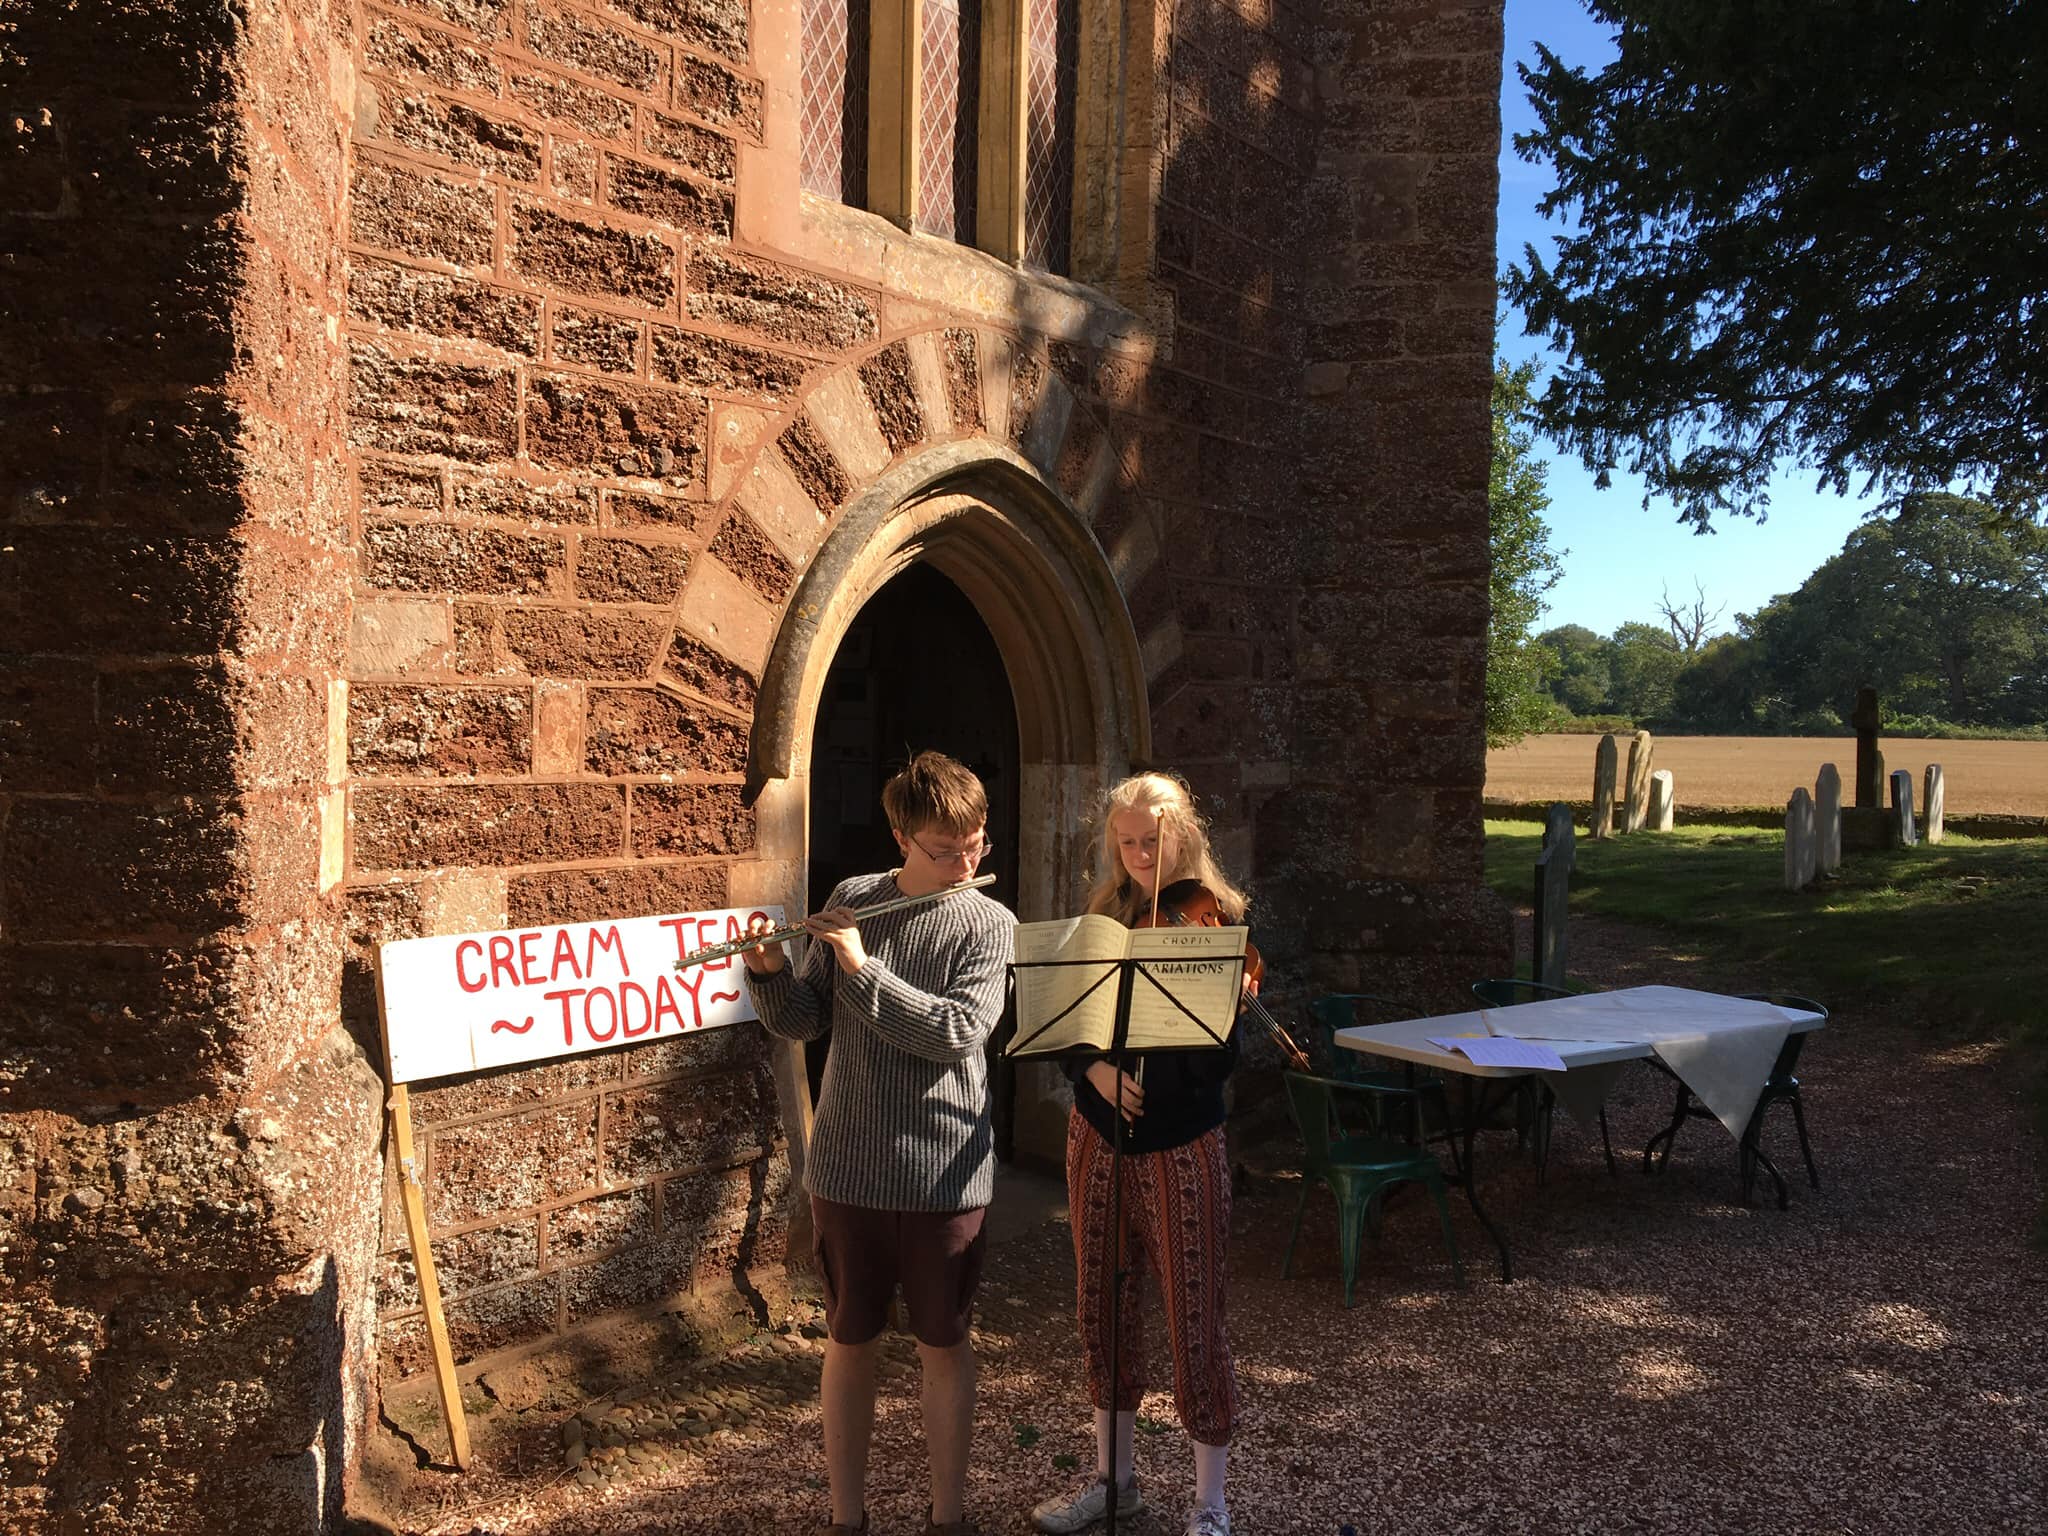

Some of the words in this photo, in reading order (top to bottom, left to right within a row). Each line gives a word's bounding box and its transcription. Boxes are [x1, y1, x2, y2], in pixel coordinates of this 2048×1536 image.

[455, 925, 630, 993] CREAM
[1162, 936, 1213, 946] CHOPIN
[544, 970, 704, 1046] TODAY
